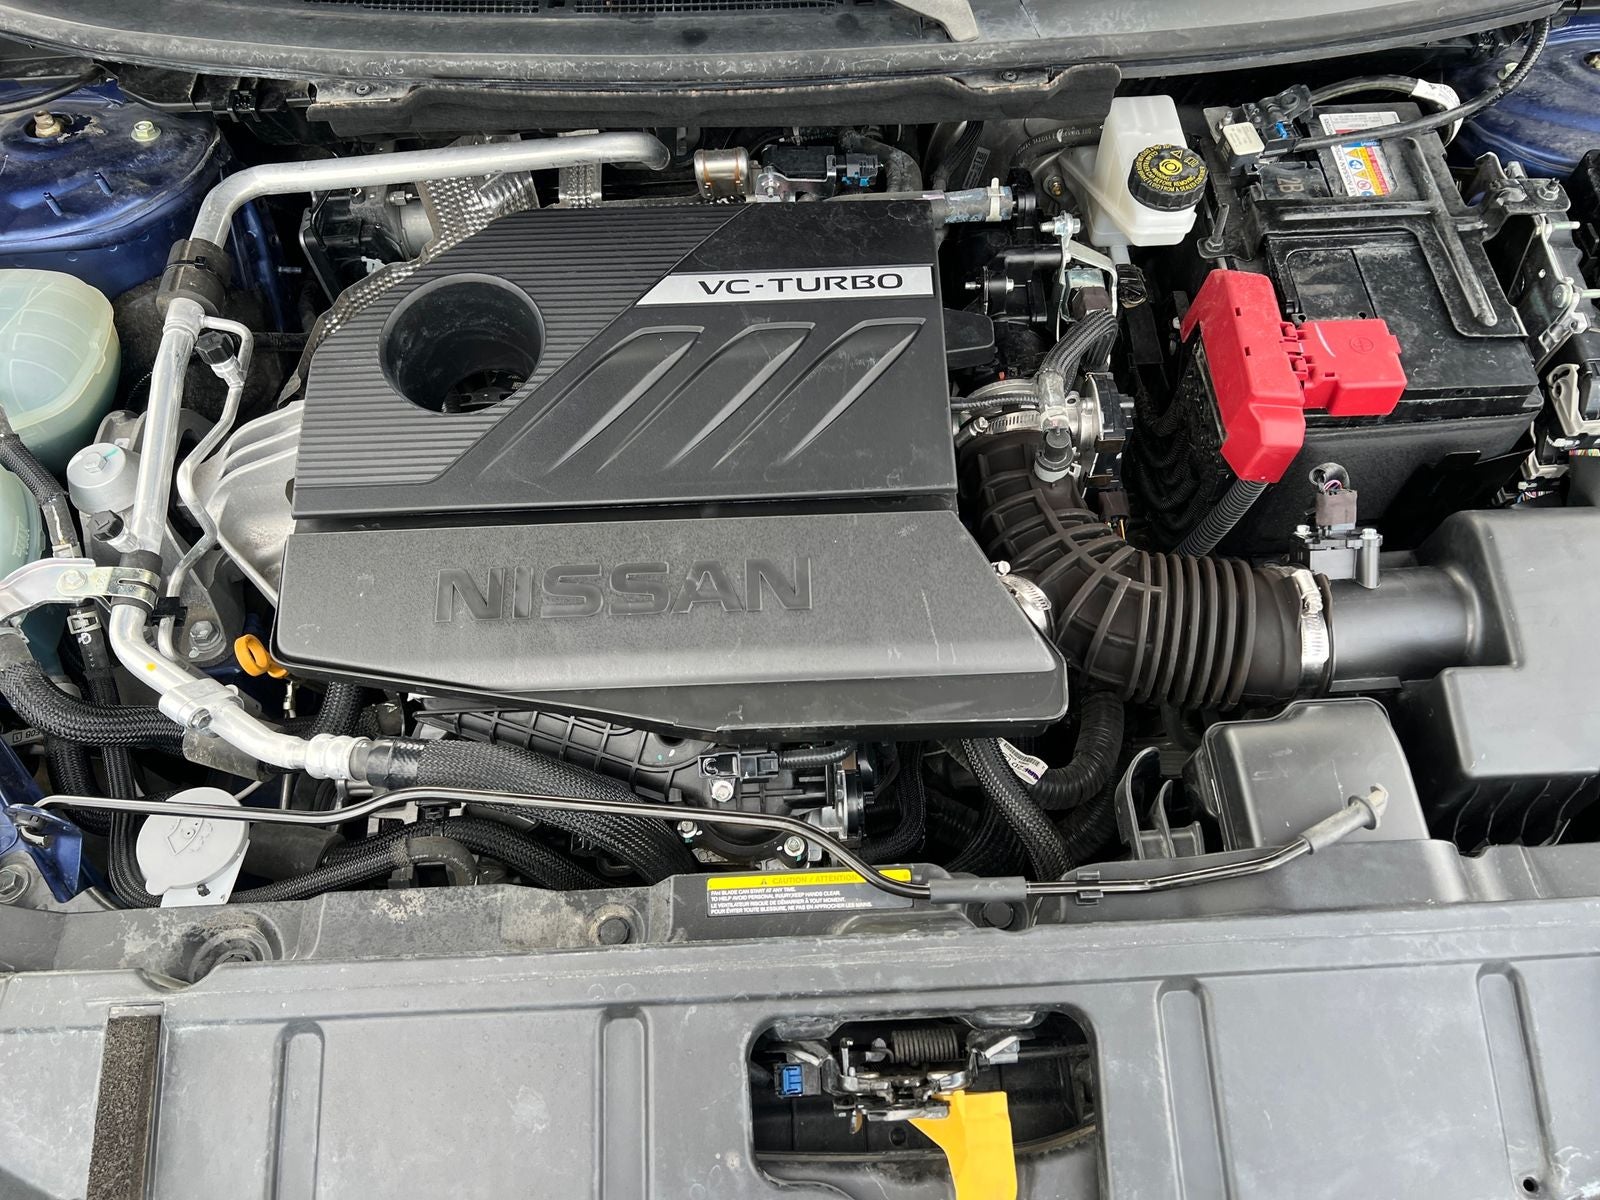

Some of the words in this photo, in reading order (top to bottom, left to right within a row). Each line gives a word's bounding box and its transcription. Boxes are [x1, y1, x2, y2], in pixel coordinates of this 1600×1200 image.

[698, 273, 903, 295] VC-TURBO
[435, 557, 812, 623] NISSAN
[773, 876, 807, 885] CAUTION
[815, 874, 858, 883] ATTENTION
